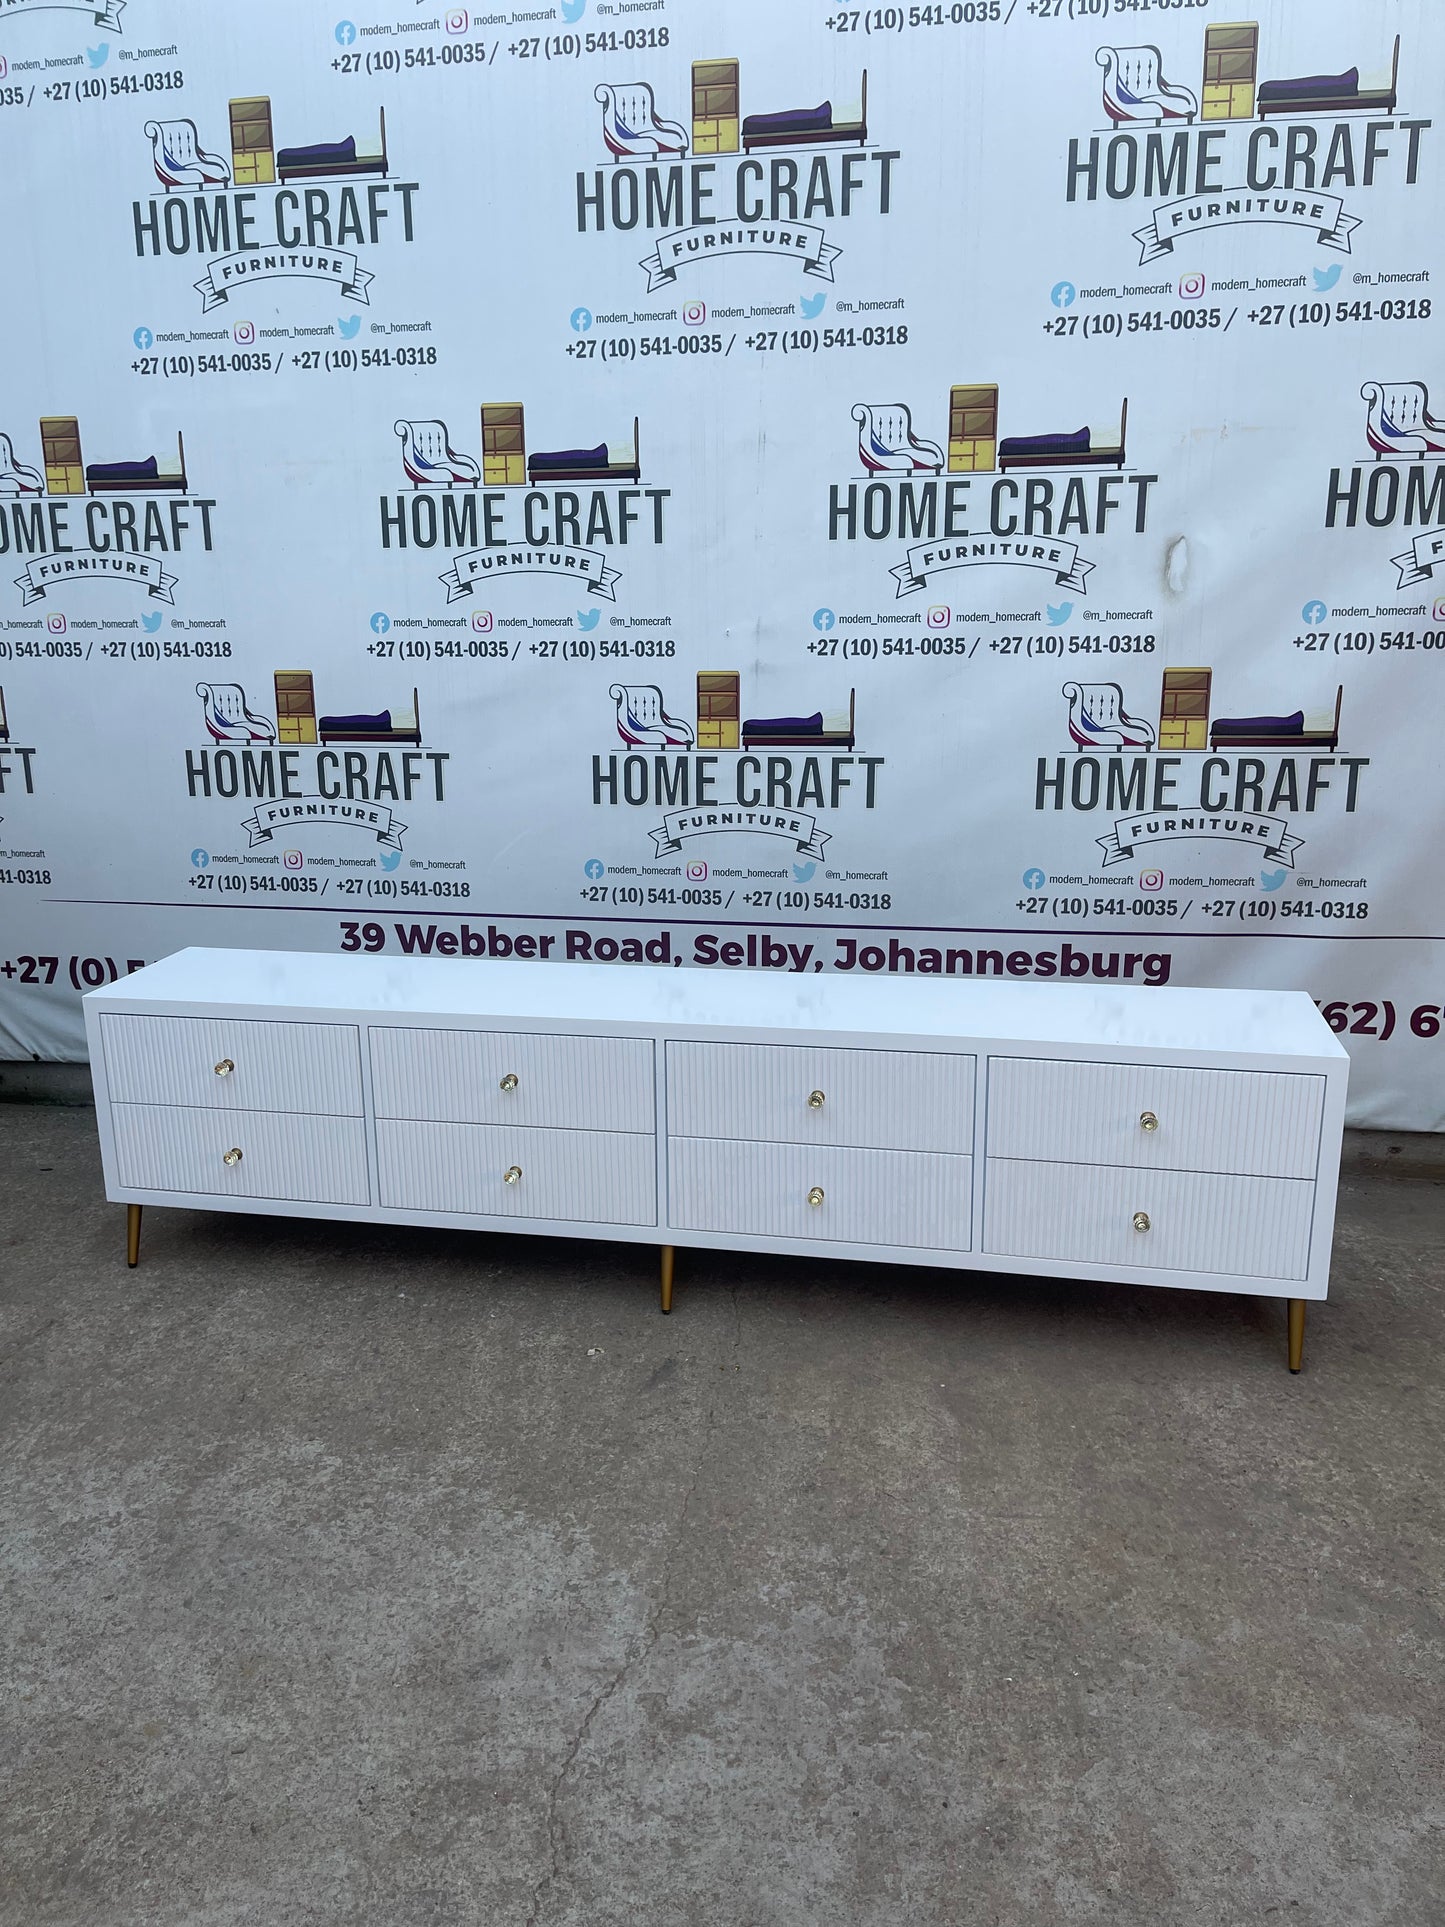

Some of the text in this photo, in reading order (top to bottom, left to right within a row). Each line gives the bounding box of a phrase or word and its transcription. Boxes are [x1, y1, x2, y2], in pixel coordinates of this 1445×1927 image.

[597, 0, 664, 15] @m_homecraft
[825, 11, 860, 32] +27
[865, 8, 904, 35] (10)
[909, 1, 1000, 27] 541-0035
[119, 45, 178, 61] @m_homecraft
[331, 53, 361, 73] +27
[366, 50, 400, 75] (10)
[405, 43, 485, 67] 541-0035
[508, 38, 540, 58] +27
[545, 34, 580, 60] (10)
[585, 27, 669, 52] 541-0318
[44, 82, 70, 100] +27
[75, 78, 106, 102] (10)
[111, 71, 183, 95] 541-0318
[1066, 120, 1432, 203] HOME CRAFT
[577, 151, 900, 233] HOME CRAFT
[133, 183, 419, 257] HOME CRAFT
[1171, 198, 1325, 228] FURNITURE
[671, 229, 809, 257] FURNITURE
[222, 254, 343, 280] FURNITURE
[1353, 271, 1429, 285] @m_homecraft
[836, 298, 904, 313] @m_homecraft
[371, 321, 432, 334] @m_homecraft
[1043, 316, 1078, 336] +27
[1083, 314, 1122, 339] (10)
[1127, 308, 1220, 332] 541-0035
[1248, 305, 1285, 325] +27
[1290, 303, 1330, 328] (10)
[1336, 299, 1431, 322] 541-0318
[566, 340, 596, 358] +27
[601, 338, 635, 361] (10)
[640, 335, 722, 356] 541-0035
[745, 332, 777, 350] +27
[782, 330, 818, 353] (10)
[823, 325, 908, 347] 541-0318
[131, 358, 158, 374] +27
[163, 356, 194, 377] (10)
[198, 353, 271, 372] 541-0035
[292, 351, 320, 369] +27
[325, 350, 357, 372] (10)
[362, 347, 437, 367] 541-0318
[380, 489, 671, 548] HOME CRAFT
[829, 475, 1158, 540] HOME CRAFT
[85, 500, 216, 553] CRAFT
[468, 553, 590, 573] FURNITURE
[923, 543, 1062, 566] FURNITURE
[40, 559, 149, 577] FURNITURE
[171, 619, 226, 630] @m_homecraft
[610, 616, 671, 628] @m_homecraft
[1083, 609, 1153, 622] @m_homecraft
[16, 642, 82, 657] 541-0035
[101, 642, 126, 657] +27
[131, 642, 160, 661] (10)
[164, 642, 232, 657] 541-0318
[367, 641, 394, 657] +27
[399, 641, 430, 660] (10)
[435, 641, 508, 657] 541-0035
[529, 641, 558, 657] +27
[563, 641, 595, 661] (10)
[600, 640, 675, 657] 541-0318
[807, 639, 838, 656] +27
[843, 639, 878, 659] (10)
[882, 638, 965, 655] 541-0035
[989, 637, 1022, 654] +27
[1027, 636, 1064, 657] (10)
[1069, 635, 1155, 653] 541-0318
[1293, 633, 1329, 651] +27
[1334, 632, 1374, 654] (10)
[185, 750, 449, 801] HOME CRAFT
[593, 755, 884, 808] HOME CRAFT
[1035, 757, 1370, 812] HOME CRAFT
[267, 805, 380, 824] FURNITURE
[678, 812, 802, 832] FURNITURE
[1132, 818, 1270, 837] FURNITURE
[410, 859, 466, 870] @m_homecraft
[826, 870, 888, 881] @m_homecraft
[189, 875, 214, 889] +27
[218, 875, 246, 893] (10)
[251, 876, 317, 892] 541-0035
[337, 879, 363, 894] +27
[367, 880, 397, 898] (10)
[401, 881, 470, 897] 541-0318
[1297, 877, 1367, 888] @m_homecraft
[580, 887, 608, 901] +27
[612, 887, 643, 906] (10)
[648, 888, 722, 905] 541-0035
[743, 891, 772, 906] +27
[777, 892, 809, 911] (10)
[814, 893, 891, 909] 541-0318
[1016, 897, 1048, 913] +27
[1053, 898, 1088, 918] (10)
[1093, 899, 1177, 916] 541-0035
[1202, 900, 1235, 916] +27
[1240, 901, 1276, 920] (10)
[1280, 901, 1368, 919] 541-0318
[340, 922, 1172, 986] 39 Webber Road, Selby, Johannesburg
[1, 956, 58, 984] +27
[69, 956, 118, 990] (0)
[1311, 1000, 1397, 1040] 62)
